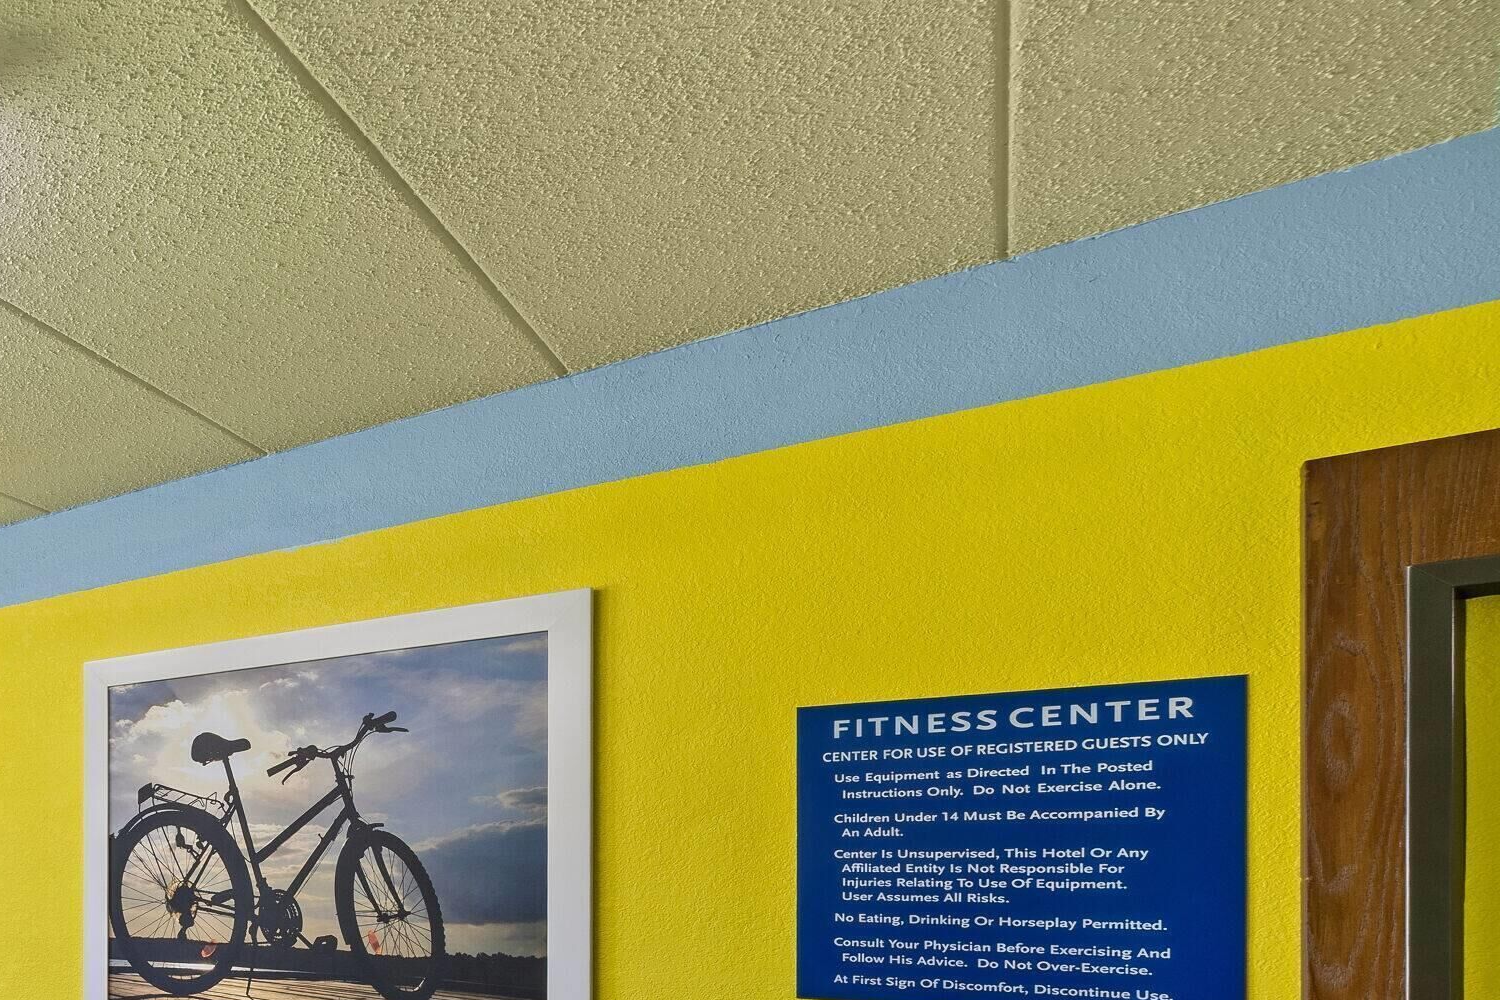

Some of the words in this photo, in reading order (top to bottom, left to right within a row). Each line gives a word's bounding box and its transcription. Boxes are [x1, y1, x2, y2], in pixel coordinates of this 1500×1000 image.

[833, 709, 998, 739] FITNESS
[1009, 696, 1194, 729] CENTER
[822, 750, 878, 763] CENTER
[883, 748, 913, 760] FOR
[916, 746, 947, 758] USE
[950, 744, 973, 757] OF
[976, 739, 1078, 755] REGISTERED
[1081, 735, 1152, 750] GUESTS
[1156, 732, 1209, 747] ONLY
[834, 773, 860, 783] Use
[865, 770, 941, 784] Equipment
[946, 771, 963, 779] as
[967, 765, 1030, 778] Directed
[1041, 765, 1056, 775] In
[1060, 763, 1092, 775] The
[1097, 759, 1153, 773] Posted
[842, 787, 923, 799] Instructions
[926, 785, 964, 799] Only.
[973, 785, 995, 795] Do
[1002, 784, 1031, 794] Not
[1037, 781, 1103, 793] Exercise
[1107, 779, 1162, 791] Alone.
[833, 812, 890, 824] Children
[894, 811, 938, 823] Under
[941, 811, 959, 822] 14
[963, 811, 1002, 821] Must
[1006, 810, 1026, 820] Be
[1029, 806, 1139, 822] Accompanied
[1144, 807, 1166, 821] By
[841, 827, 860, 838] An
[863, 826, 904, 837] Adult.
[833, 849, 878, 859] Center
[881, 849, 893, 859] Is
[897, 847, 1000, 862] Unsupervised,
[1003, 847, 1037, 859] This
[1042, 847, 1085, 859] Hotel
[1089, 847, 1113, 858] Or
[1116, 847, 1149, 861] Any
[841, 862, 901, 873] Affiliated
[905, 862, 946, 876] Entity
[950, 863, 963, 874] Is
[967, 863, 996, 874] Not
[999, 862, 1094, 877] Responsible
[1098, 863, 1125, 874] For
[842, 877, 892, 889] Injuries
[896, 877, 954, 891] Relating
[956, 878, 974, 888] To
[978, 878, 1008, 889] Use
[1011, 877, 1034, 889] Of
[1036, 878, 1128, 892] Equipment.
[842, 891, 874, 901] User
[876, 892, 940, 903] Assumes
[943, 892, 962, 903] All
[967, 892, 1010, 904] Risks.
[834, 912, 855, 923] No
[858, 913, 905, 927] Eating,
[908, 914, 971, 929] Drinking
[973, 916, 995, 926] Or
[998, 916, 1077, 931] Horseplay
[1082, 918, 1168, 931] Permitted.
[833, 937, 885, 948] Consult
[888, 939, 920, 950] Your
[924, 939, 991, 953] Physician
[996, 942, 1045, 955] Before
[1050, 944, 1133, 961] Exercising
[1136, 947, 1171, 959] And
[842, 952, 885, 964] Follow
[889, 954, 913, 965] His
[916, 955, 968, 968] Advice.
[977, 958, 999, 969] Do
[1004, 959, 1033, 970] Not
[1036, 960, 1153, 976] Over-Exercise.
[833, 974, 849, 984] At
[852, 975, 882, 986] First
[885, 976, 916, 990] Sign
[919, 978, 941, 989] Of
[942, 979, 1029, 996] Discomfort,
[1034, 984, 1131, 1000] Discontinue
